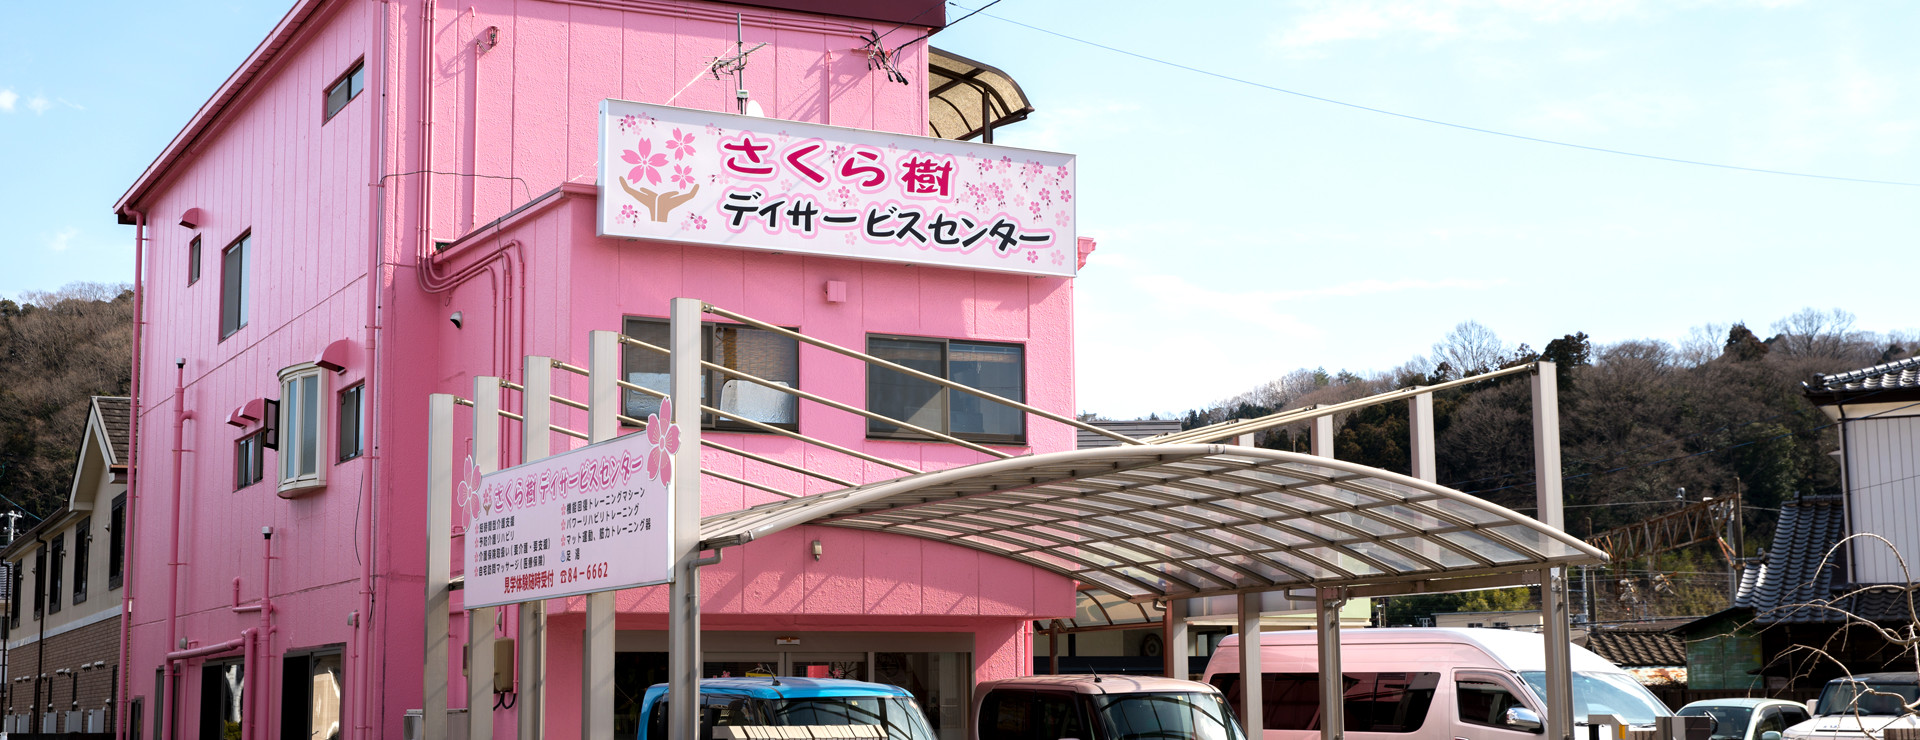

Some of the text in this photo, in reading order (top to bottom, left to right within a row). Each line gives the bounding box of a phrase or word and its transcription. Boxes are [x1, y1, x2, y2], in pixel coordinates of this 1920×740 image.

[723, 137, 954, 199] さくら樹
[722, 190, 1051, 252] デイサービスセンター
[494, 475, 537, 512] さくら樹
[540, 450, 643, 503] デイサービスセンター
[504, 568, 554, 594] 見学体験随時受付
